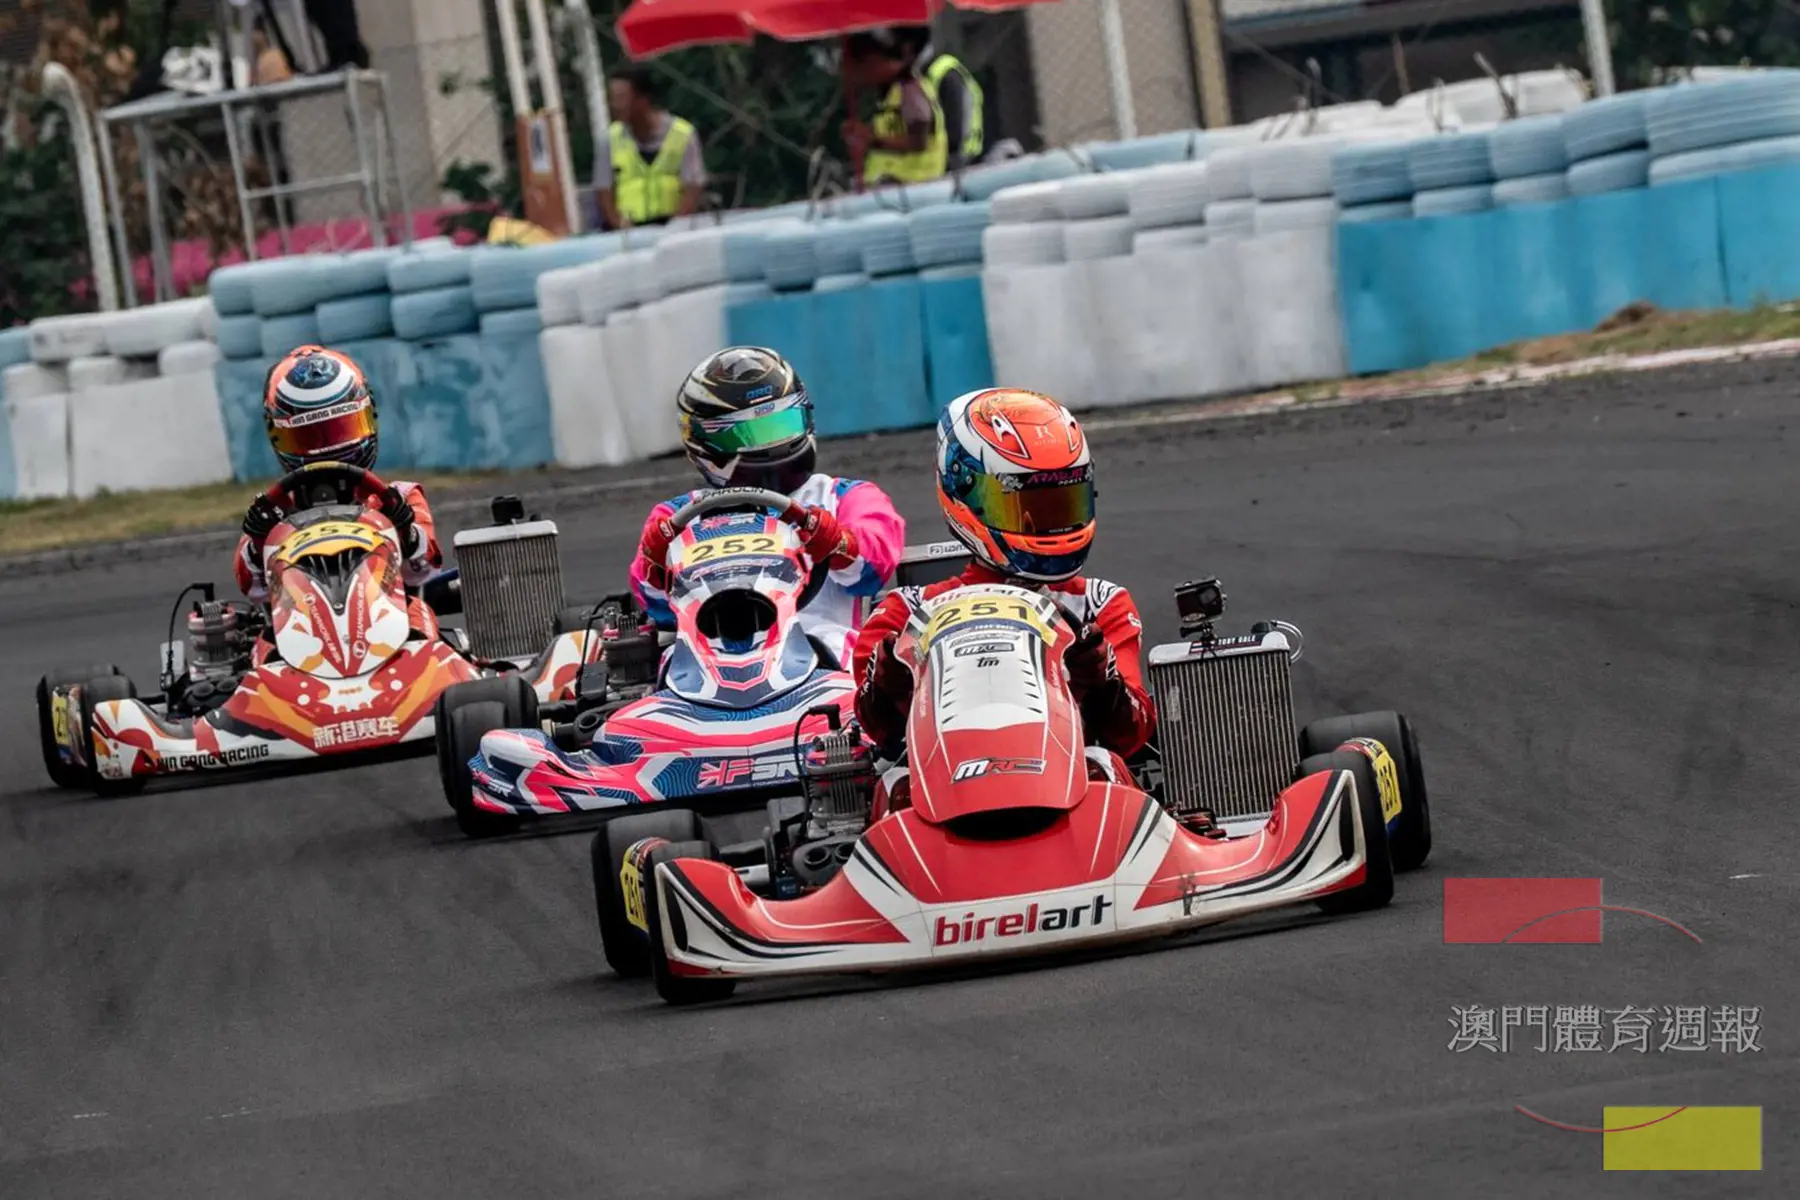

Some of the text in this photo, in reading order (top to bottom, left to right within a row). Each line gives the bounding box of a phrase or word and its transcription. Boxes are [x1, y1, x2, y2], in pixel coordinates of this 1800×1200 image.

[293, 524, 364, 548] 257
[691, 538, 776, 563] 252
[934, 602, 1029, 630] 251
[1218, 634, 1256, 646] TOBY GALE
[313, 715, 401, 749] 新港赛车
[934, 894, 1113, 947] birelart
